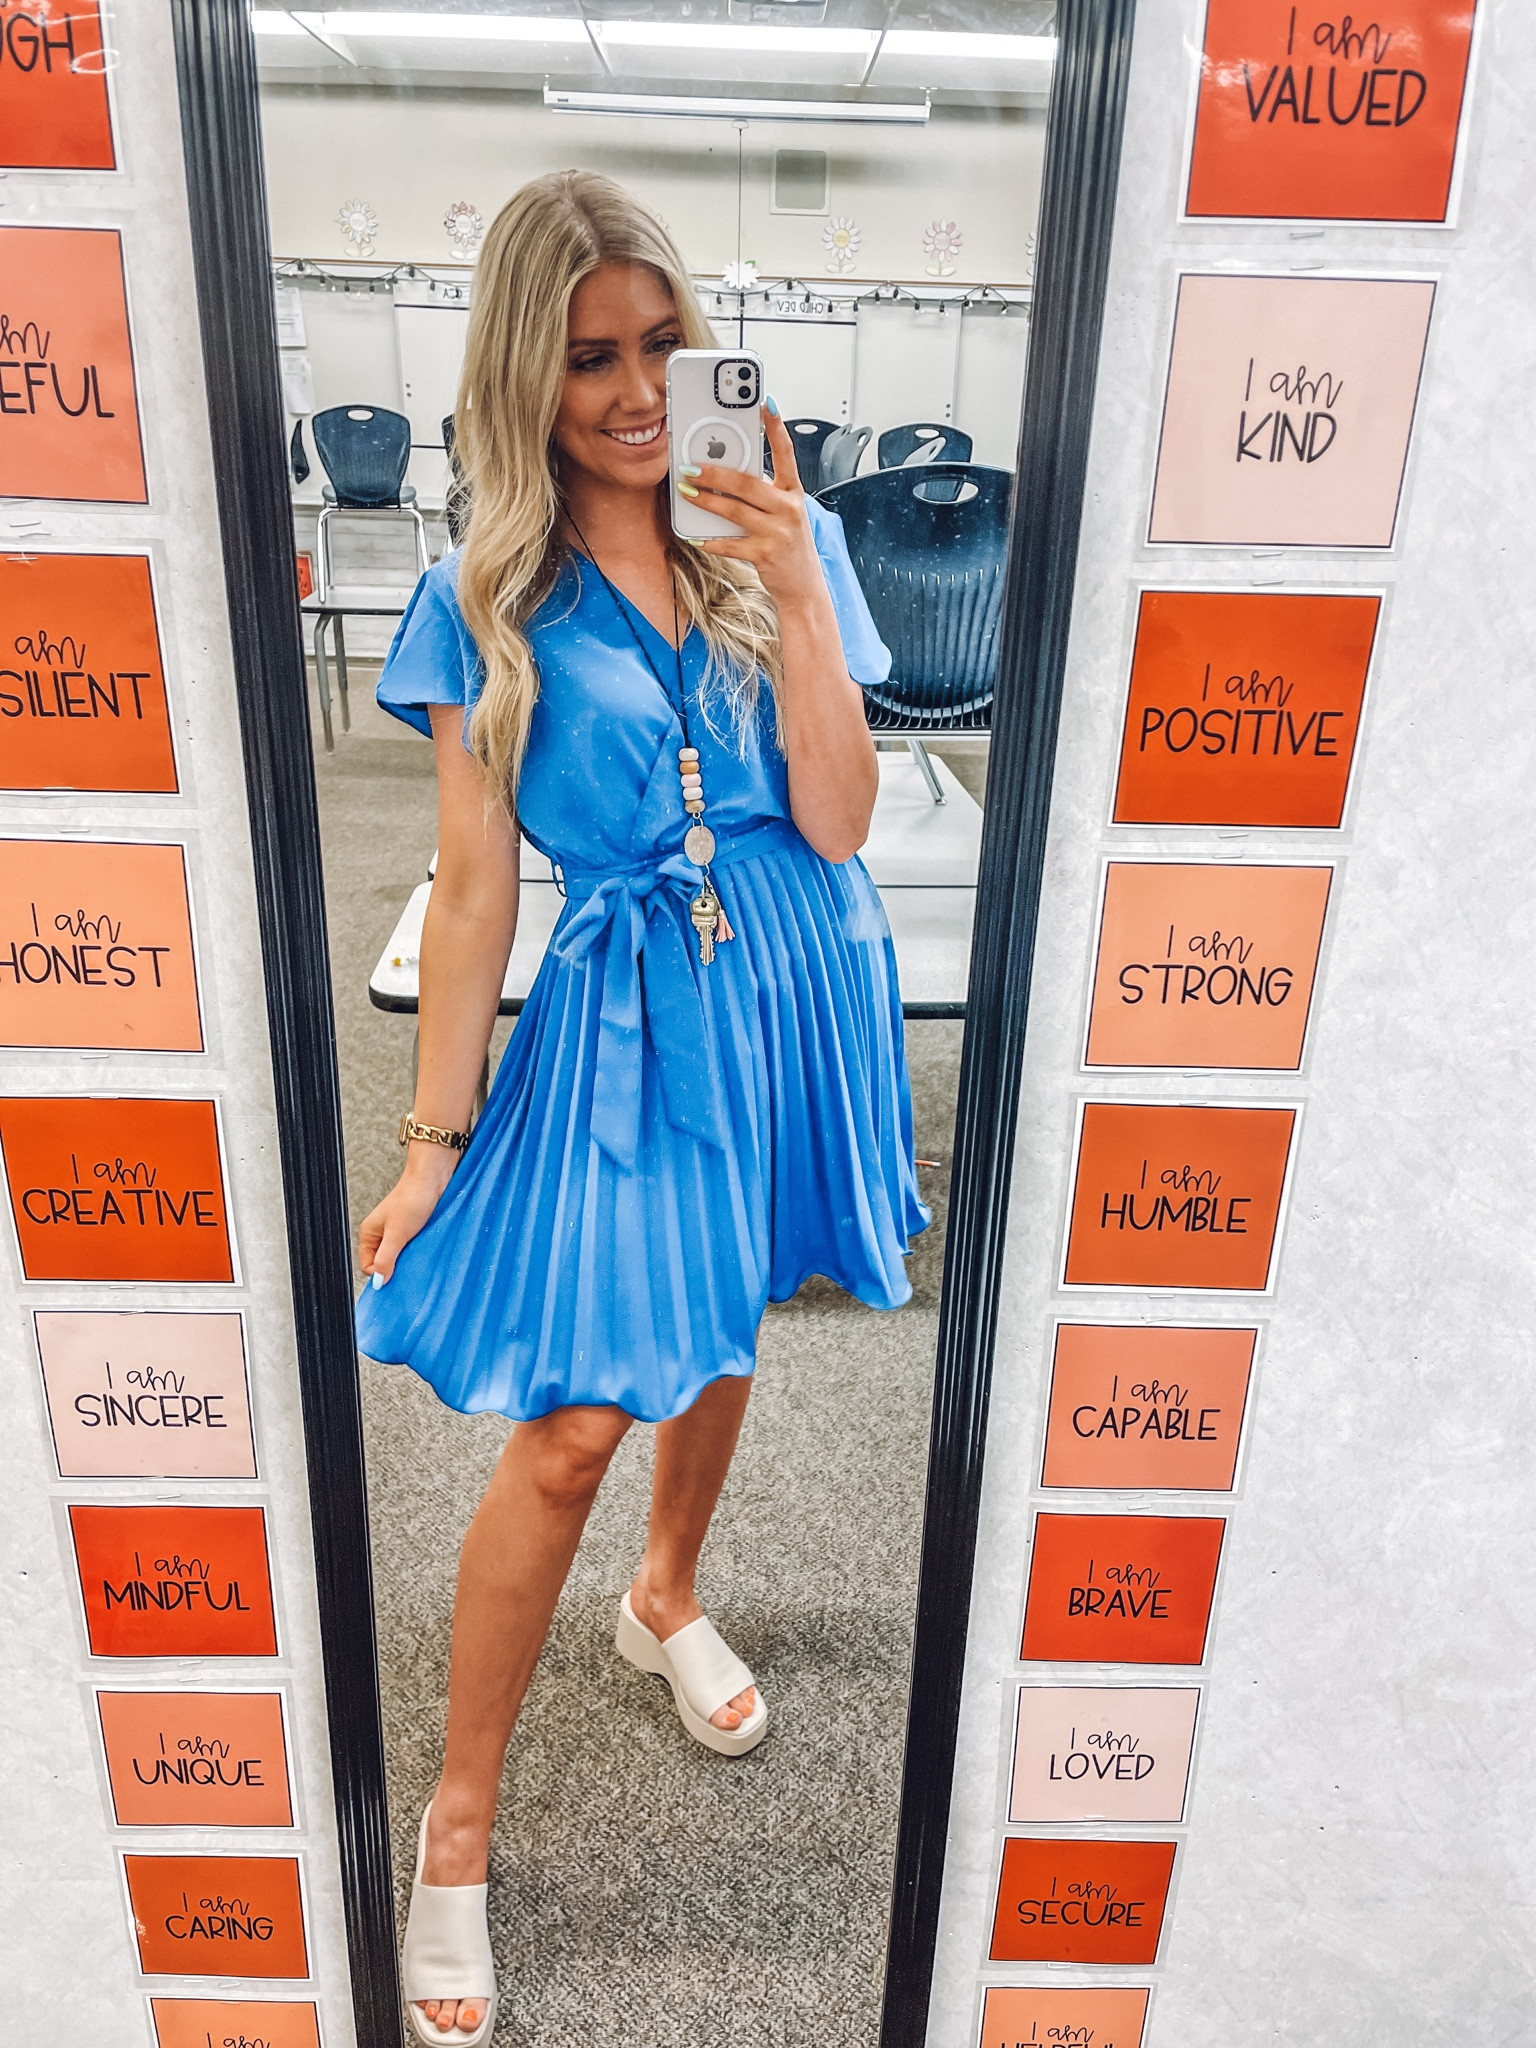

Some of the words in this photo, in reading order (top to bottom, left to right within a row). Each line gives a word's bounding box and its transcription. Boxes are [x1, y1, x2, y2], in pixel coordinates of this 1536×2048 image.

[0, 12, 76, 73] GH
[1313, 15, 1392, 64] am
[1244, 64, 1427, 127] VALUED
[1269, 365, 1343, 408] am
[1237, 411, 1336, 463] KIND
[14, 629, 86, 668] am
[0, 670, 150, 719] SILIENT
[1225, 669, 1294, 707] am
[1140, 707, 1344, 757] POSITIVE
[54, 909, 121, 943] am
[1188, 930, 1254, 964] am
[1120, 964, 1293, 1006] STRONG
[93, 1157, 157, 1187] am
[1160, 1164, 1222, 1195] am
[23, 1189, 217, 1226] CREATIVE
[1101, 1192, 1252, 1234] HUMBLE
[126, 1366, 185, 1393] am
[1130, 1379, 1189, 1406] am
[75, 1394, 227, 1427] SINCERE
[1072, 1406, 1221, 1441] CAPABLE
[153, 1555, 211, 1579] am
[1105, 1563, 1162, 1588] am
[104, 1580, 250, 1610] MINDFUL
[1068, 1587, 1172, 1619] BRAVE
[177, 1735, 230, 1758] am
[1087, 1730, 1140, 1752] am
[133, 1759, 264, 1786] UNIQUE
[1050, 1753, 1154, 1780] LOVED
[199, 1895, 250, 1915] am
[1067, 1880, 1118, 1901] am
[166, 1916, 273, 1940] CARING
[1017, 1900, 1146, 1927] SECURE
[1047, 2024, 1095, 2043] am
